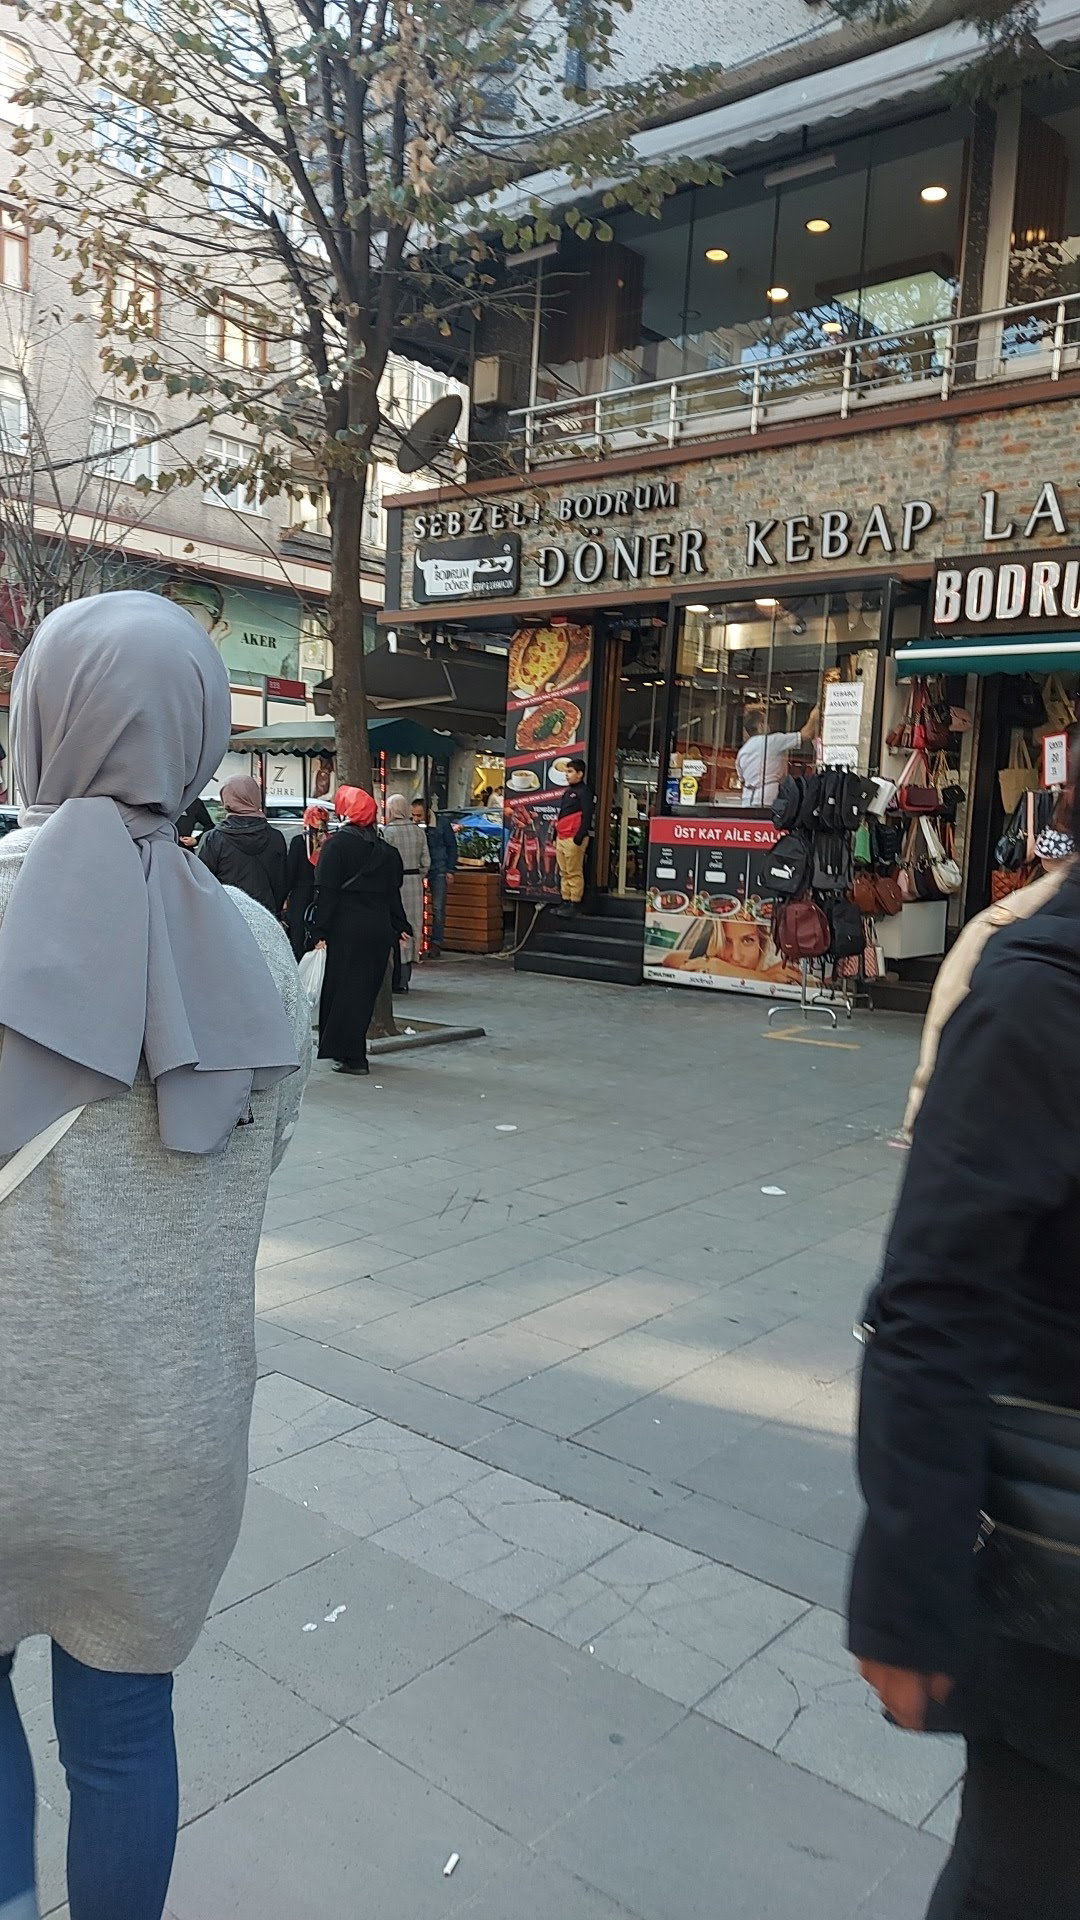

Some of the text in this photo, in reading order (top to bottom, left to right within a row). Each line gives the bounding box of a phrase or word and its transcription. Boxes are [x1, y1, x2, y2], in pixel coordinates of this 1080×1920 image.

[559, 482, 678, 521] BODRUM
[538, 480, 1080, 587] DÖNER KEBAP LA
[240, 632, 277, 649] AKER
[674, 825, 696, 839] ÜST
[698, 827, 722, 840] KAT
[724, 828, 752, 842] AİLE
